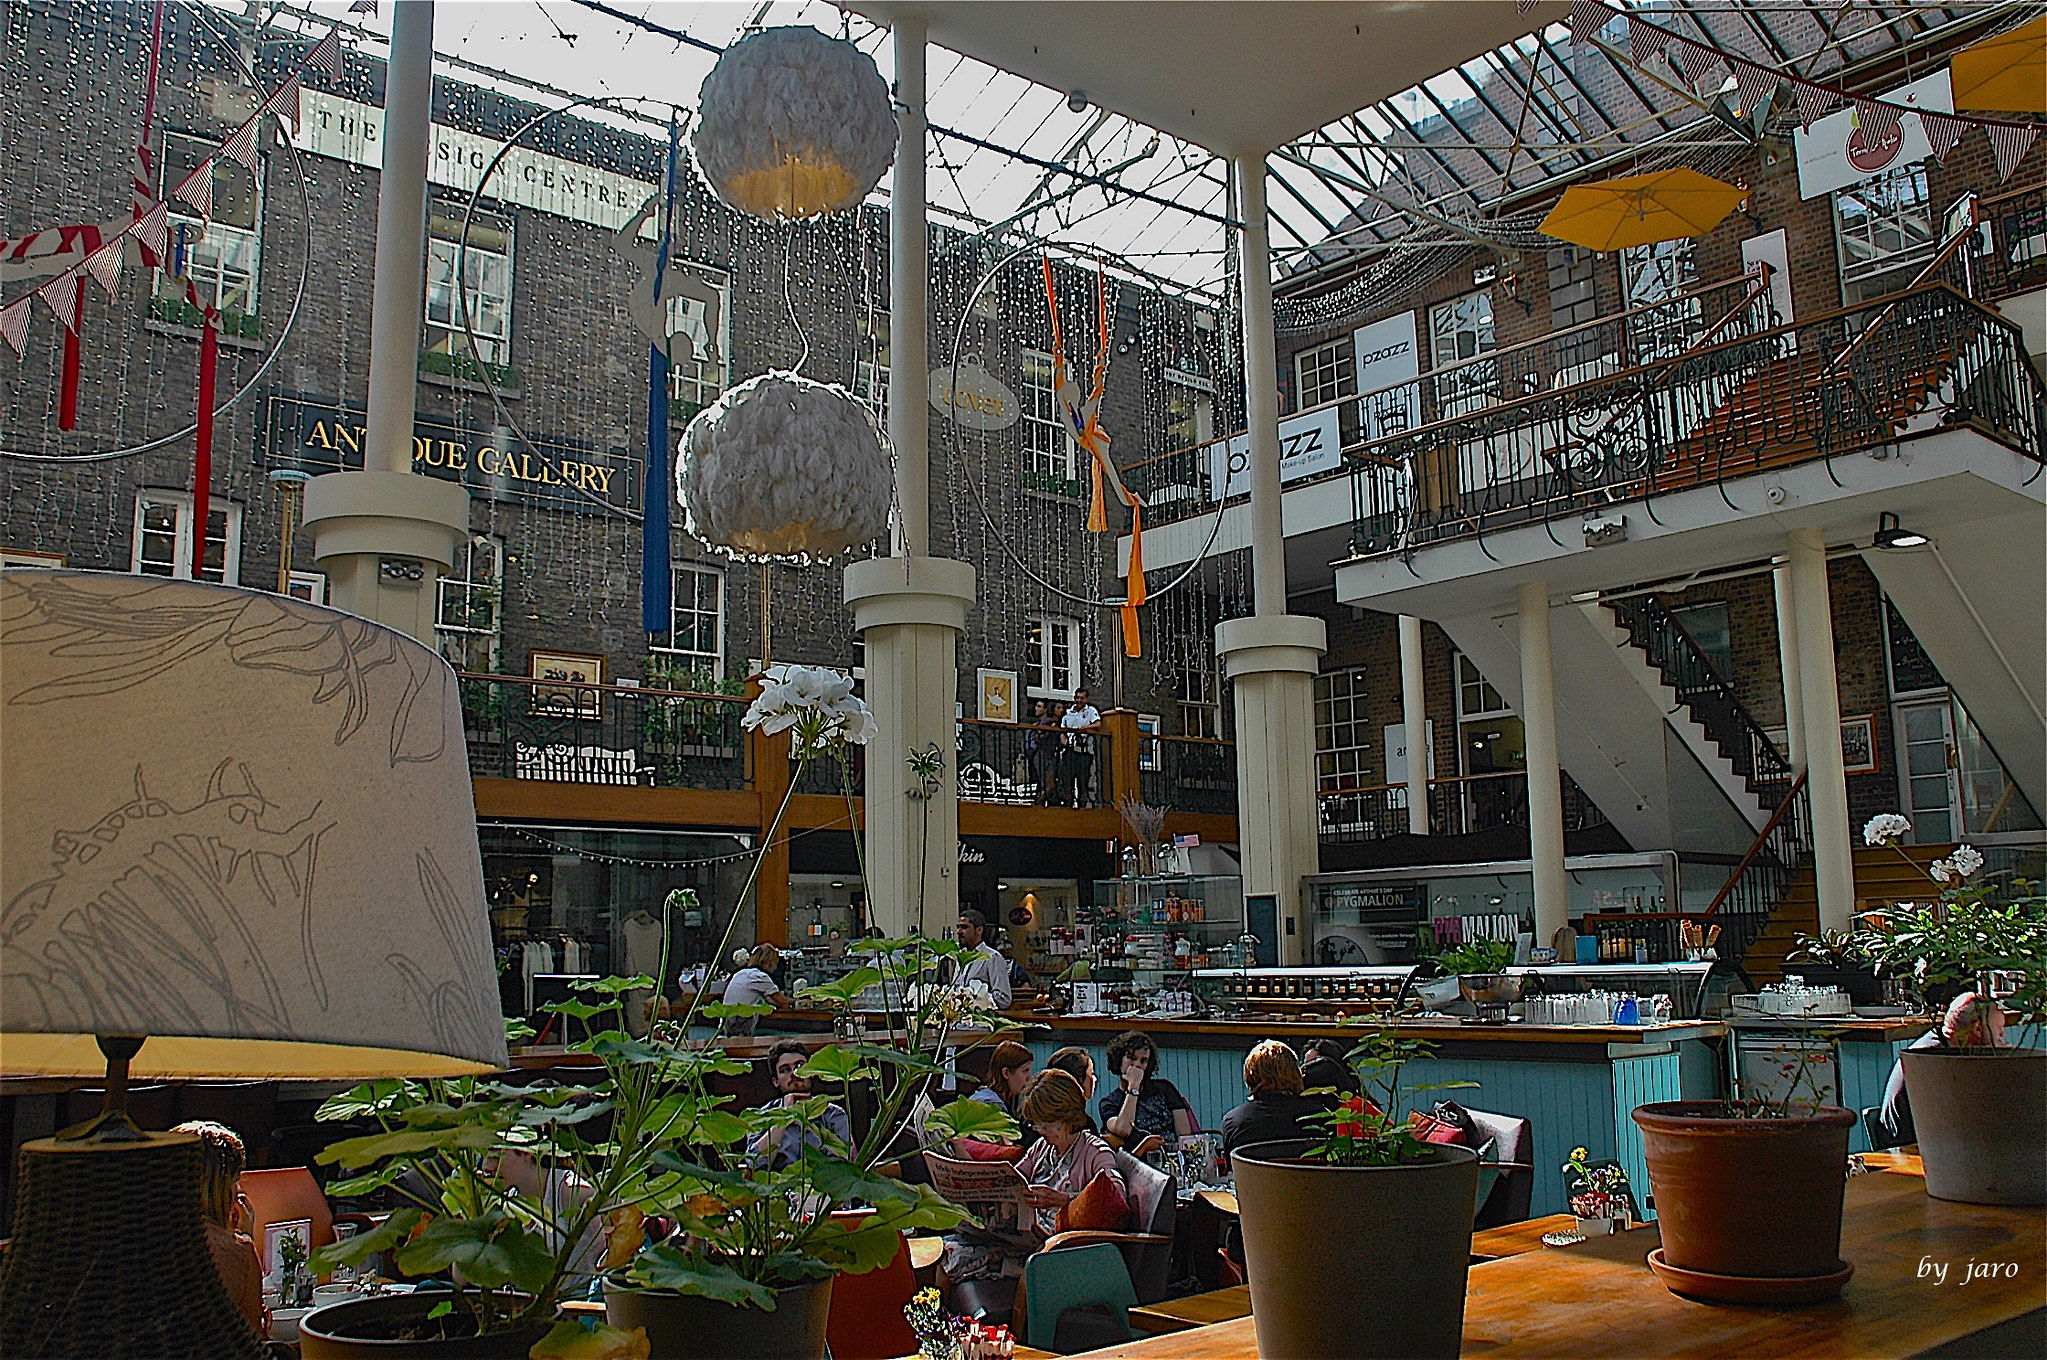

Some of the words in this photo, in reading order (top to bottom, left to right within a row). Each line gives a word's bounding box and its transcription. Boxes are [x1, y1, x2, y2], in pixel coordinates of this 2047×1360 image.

[317, 109, 377, 142] THE
[438, 142, 506, 176] SIGN
[523, 166, 628, 208] CENTRE
[1363, 341, 1409, 369] pzazz
[305, 421, 467, 469] ANUE
[477, 447, 616, 493] GALLERY
[957, 841, 985, 863] kin
[1336, 894, 1404, 908] PYGMALION
[1434, 914, 1519, 944] PYGMALION
